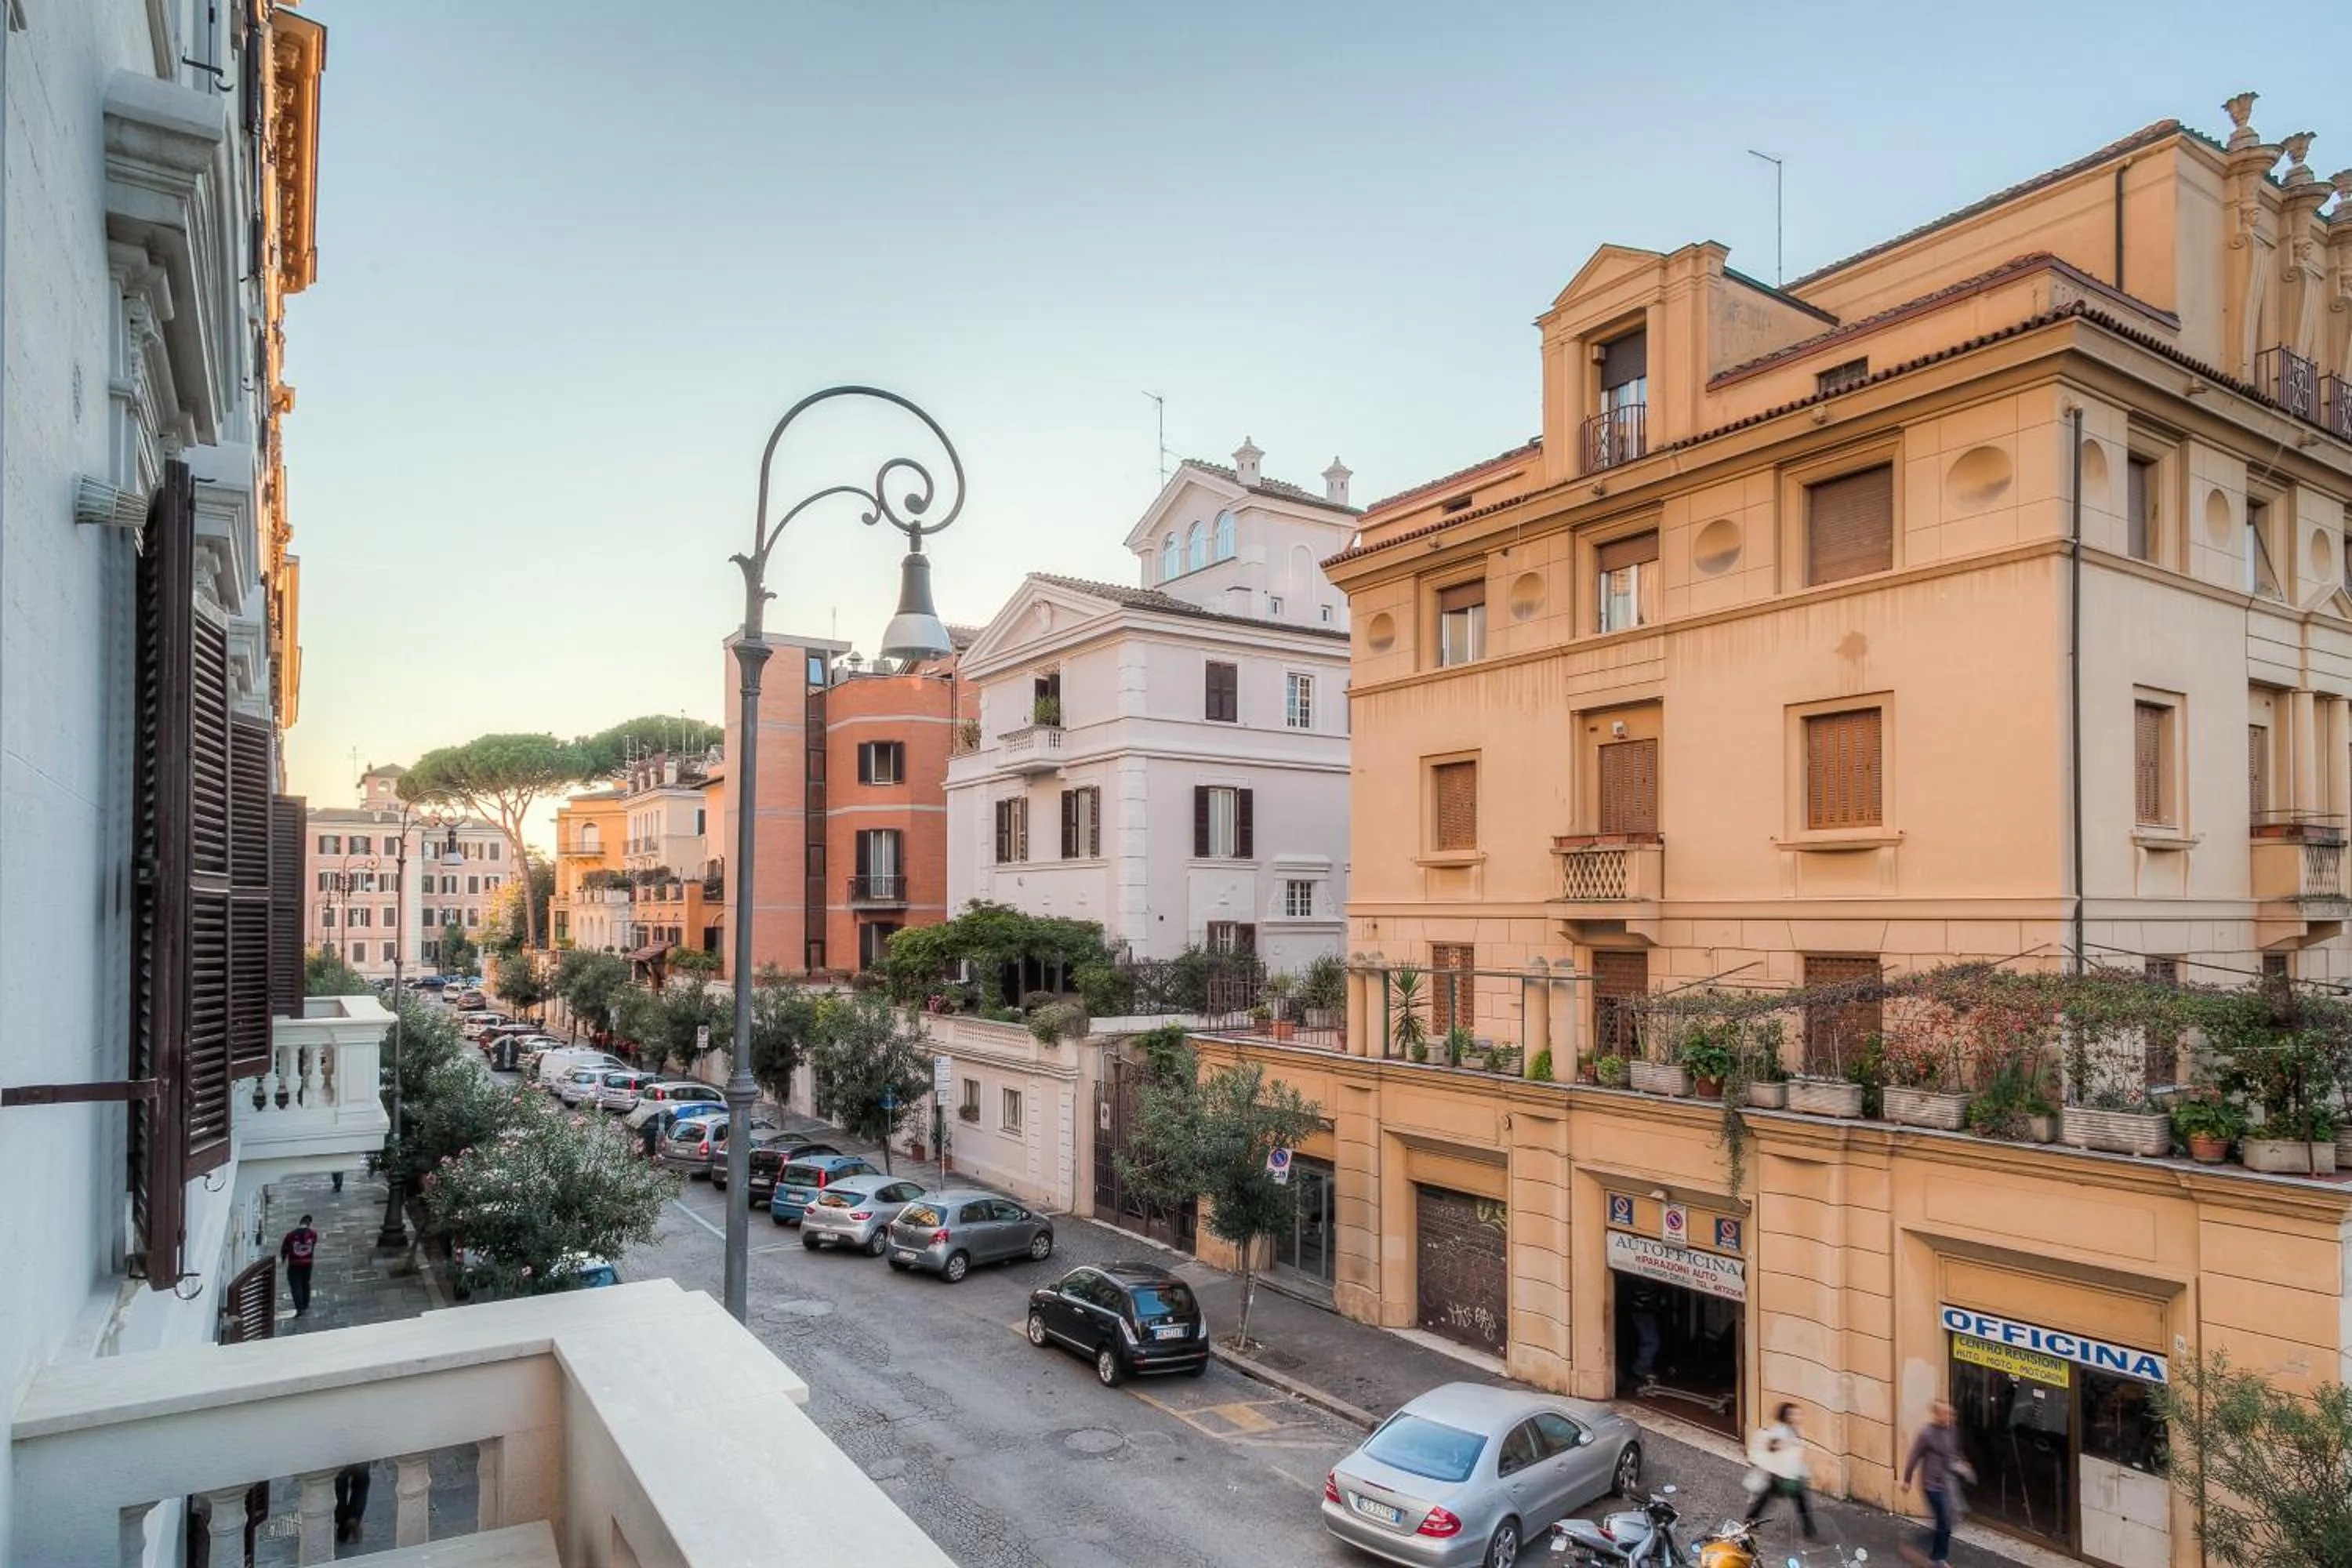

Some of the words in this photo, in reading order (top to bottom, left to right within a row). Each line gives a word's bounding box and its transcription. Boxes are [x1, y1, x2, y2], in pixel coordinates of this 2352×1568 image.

[1616, 1236, 1738, 1276] AUTOFFICINA
[1693, 1268, 1718, 1282] AUTO
[1944, 1309, 2164, 1381] OFFICINA
[1959, 1336, 2002, 1355] CENTRO
[2005, 1348, 2062, 1370] REVISIONI
[1987, 1357, 2013, 1369] MOTO
